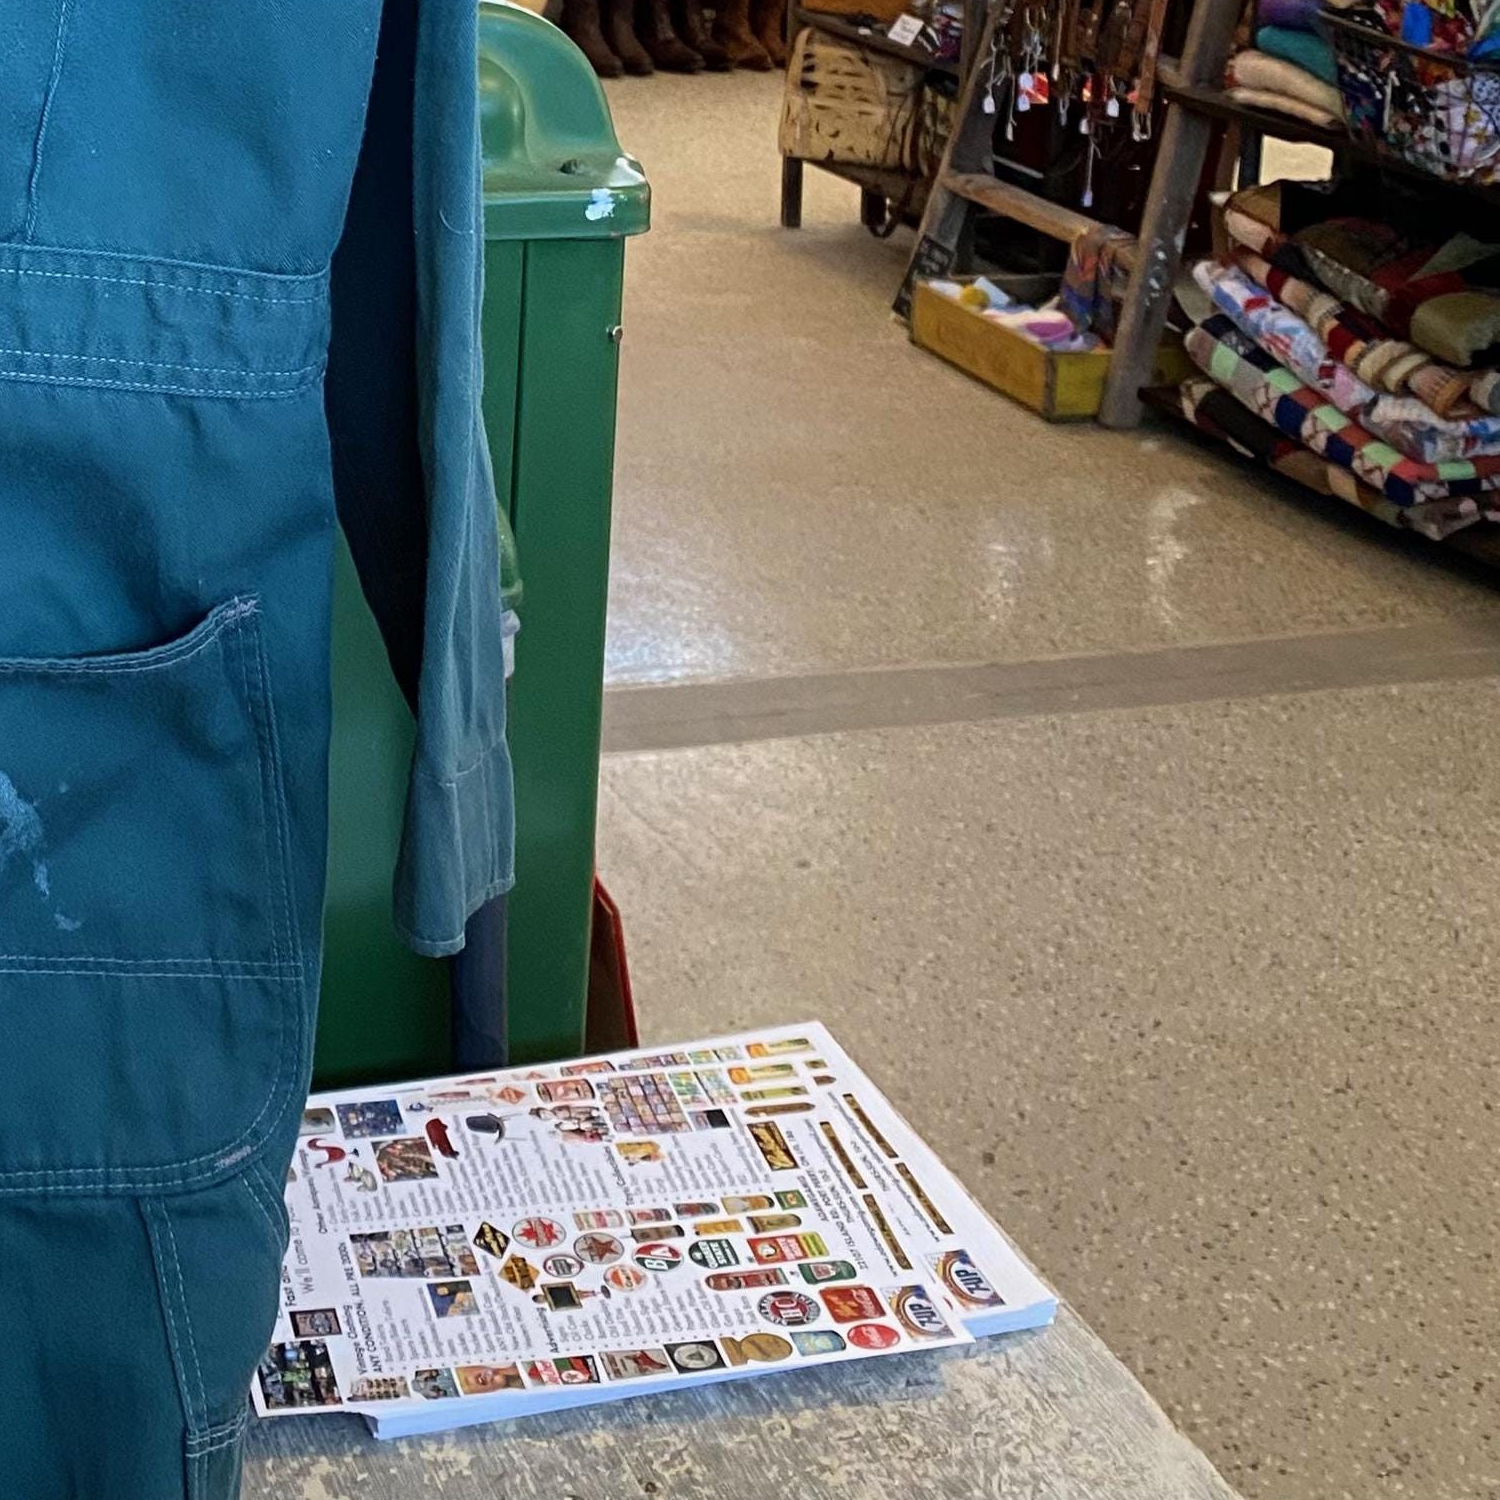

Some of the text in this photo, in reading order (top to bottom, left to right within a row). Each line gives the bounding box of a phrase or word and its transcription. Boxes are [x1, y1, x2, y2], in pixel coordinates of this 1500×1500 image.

[797, 1155, 811, 1166] ON
[816, 1189, 833, 1206] PORT
[833, 1220, 856, 1247] ISLAND
[294, 1238, 307, 1265] come
[848, 1247, 869, 1269] 22107
[298, 1267, 314, 1293] We'll
[343, 1266, 356, 1280] PRE
[348, 1283, 361, 1296] ALL
[340, 1304, 370, 1374] Vintage Clothing
[532, 1306, 563, 1354] Advertising
[368, 1354, 383, 1372] ANY
